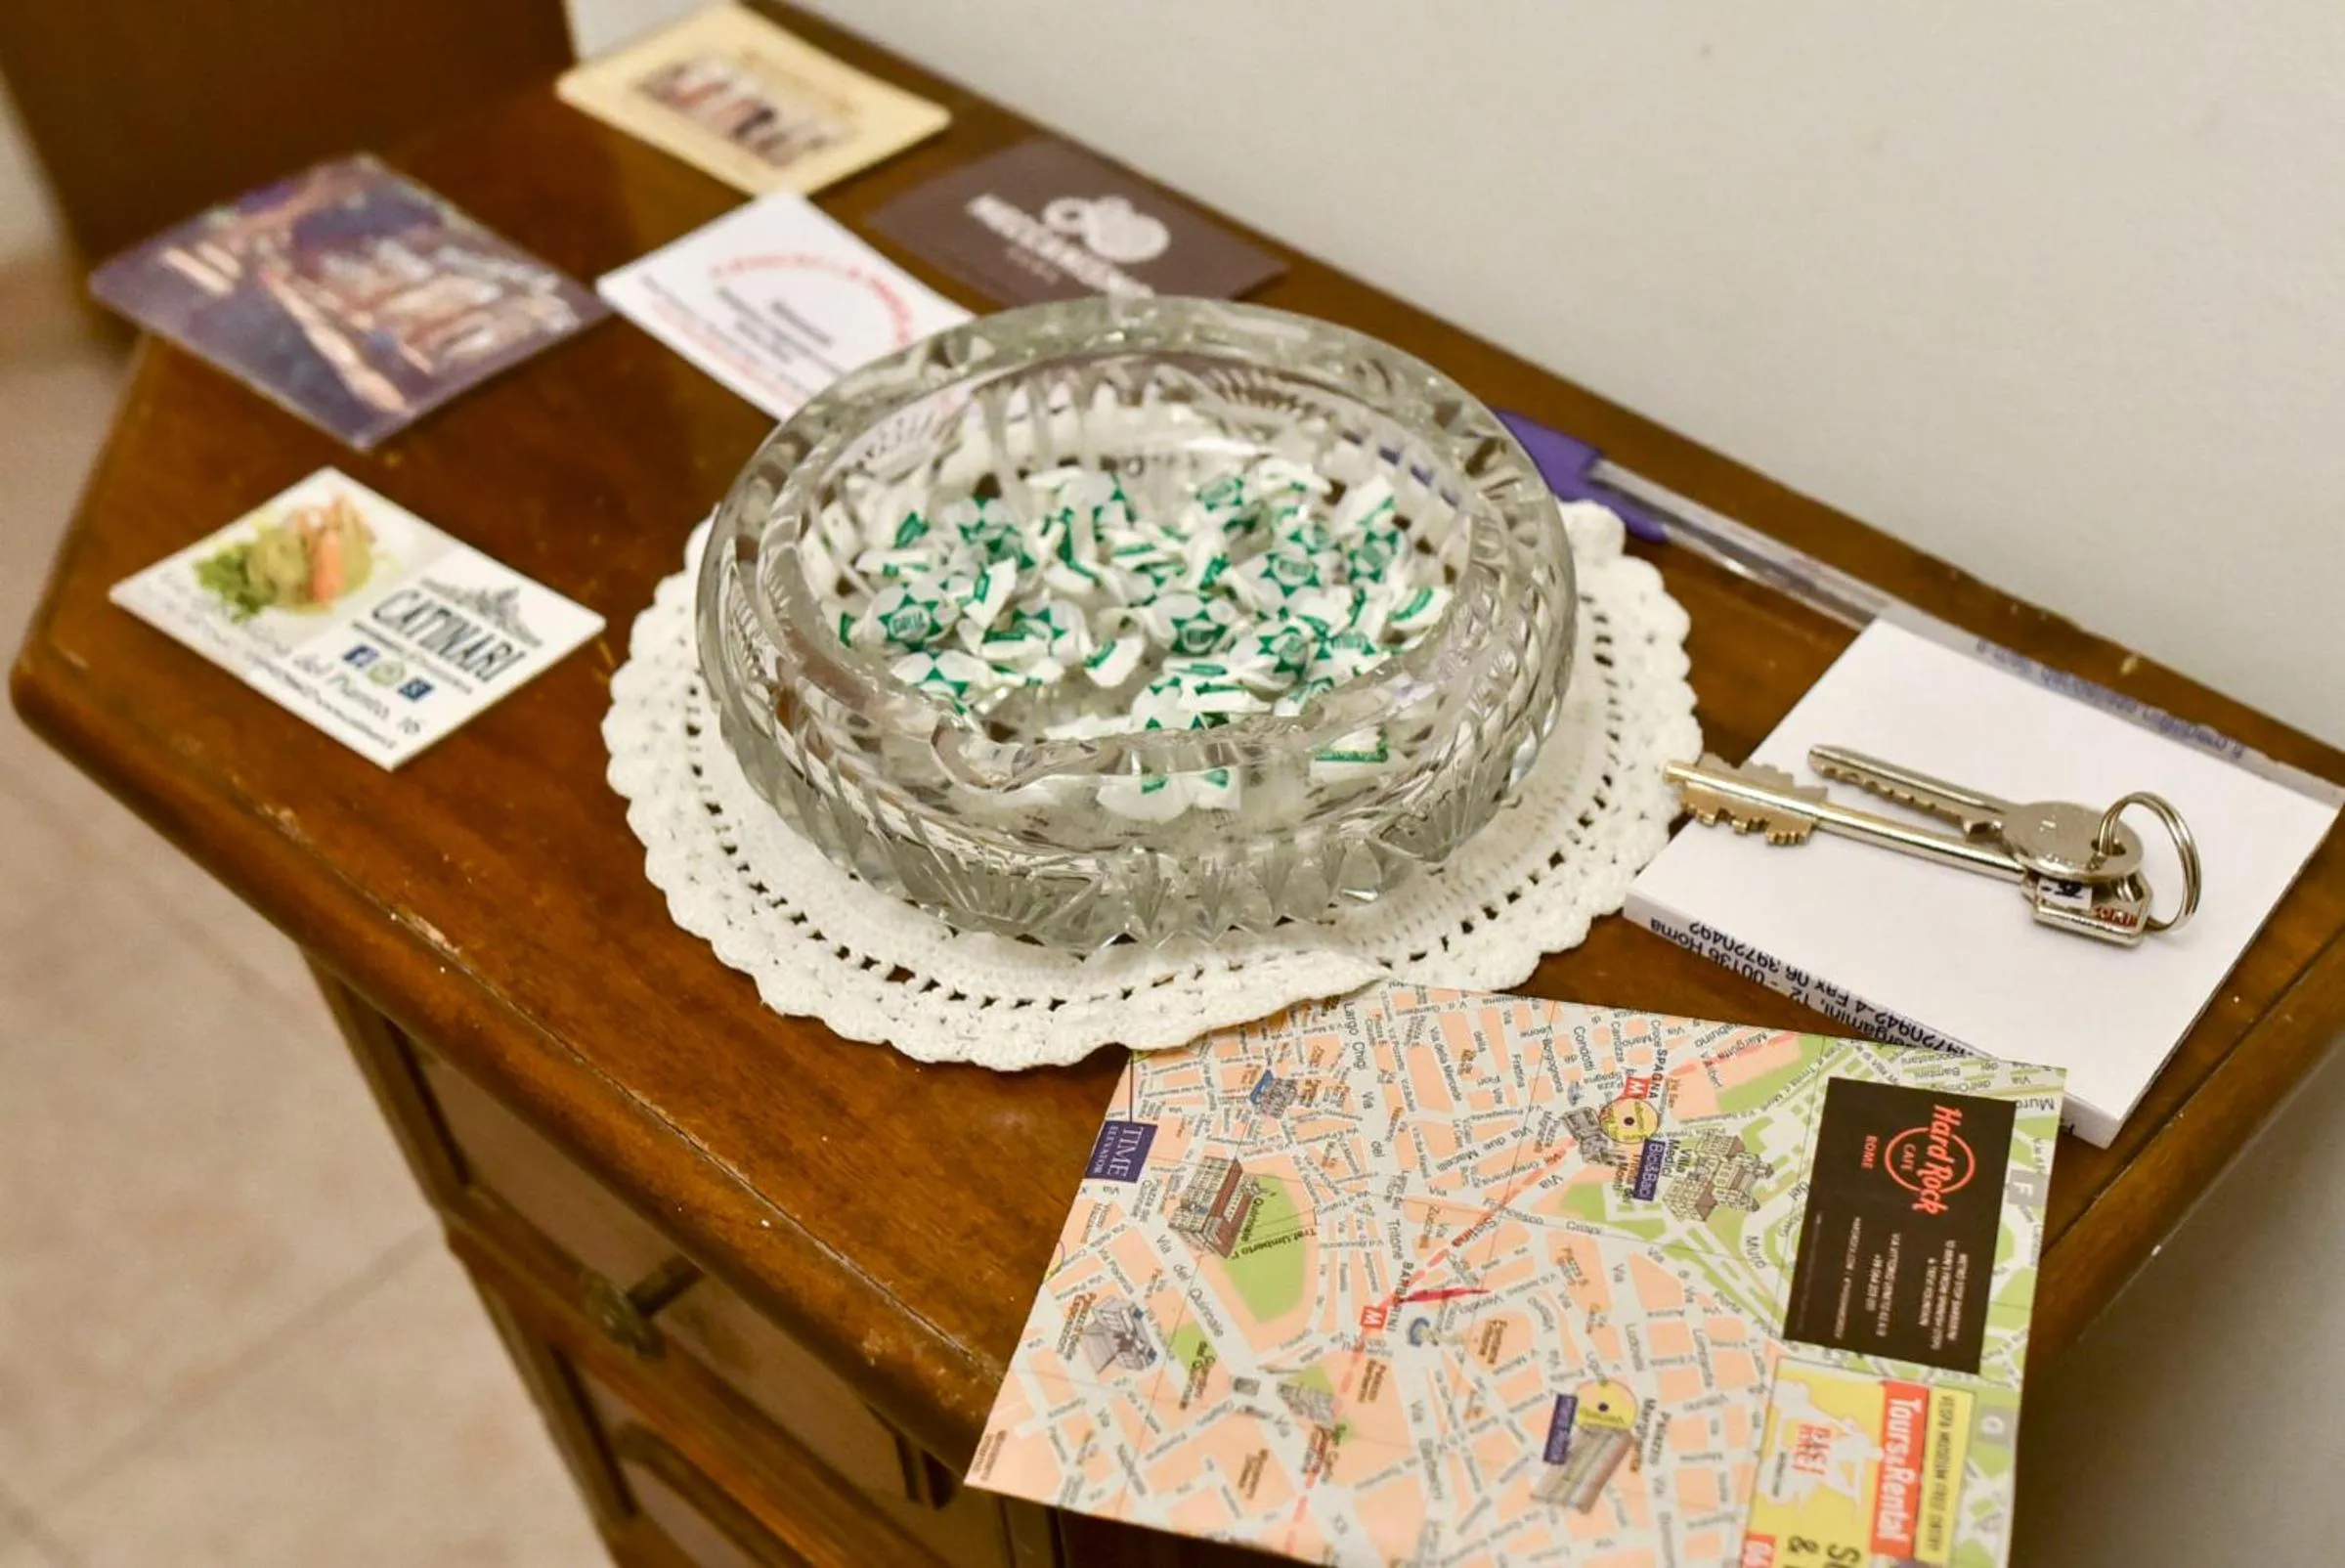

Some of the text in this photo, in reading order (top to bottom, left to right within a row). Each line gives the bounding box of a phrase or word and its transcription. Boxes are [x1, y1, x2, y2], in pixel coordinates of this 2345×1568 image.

[1343, 1002, 1367, 1070] Largo Chigi
[1573, 1025, 1595, 1072] Condotti
[1694, 1024, 1736, 1048] abuino
[1650, 1049, 1669, 1100] SPAGNA
[1093, 1124, 1118, 1175] ELEVATOR
[1107, 1125, 1145, 1180] TIME
[1436, 1126, 1534, 1173] Via due Macelli
[1664, 1138, 1680, 1179] Medici
[1677, 1148, 1692, 1174] Villa
[1859, 1134, 1877, 1169] ROME
[1899, 1143, 1917, 1171] CAFE
[1911, 1104, 1964, 1216] Hard Rock
[1363, 1091, 1405, 1260] Via del Tritone
[1539, 1174, 1564, 1190] Via
[1241, 1198, 1264, 1242] Quirinale
[1744, 1234, 1767, 1270] Muro
[1156, 1233, 1172, 1256] Via
[1173, 1263, 1191, 1282] del
[1189, 1286, 1223, 1338] Quirinale
